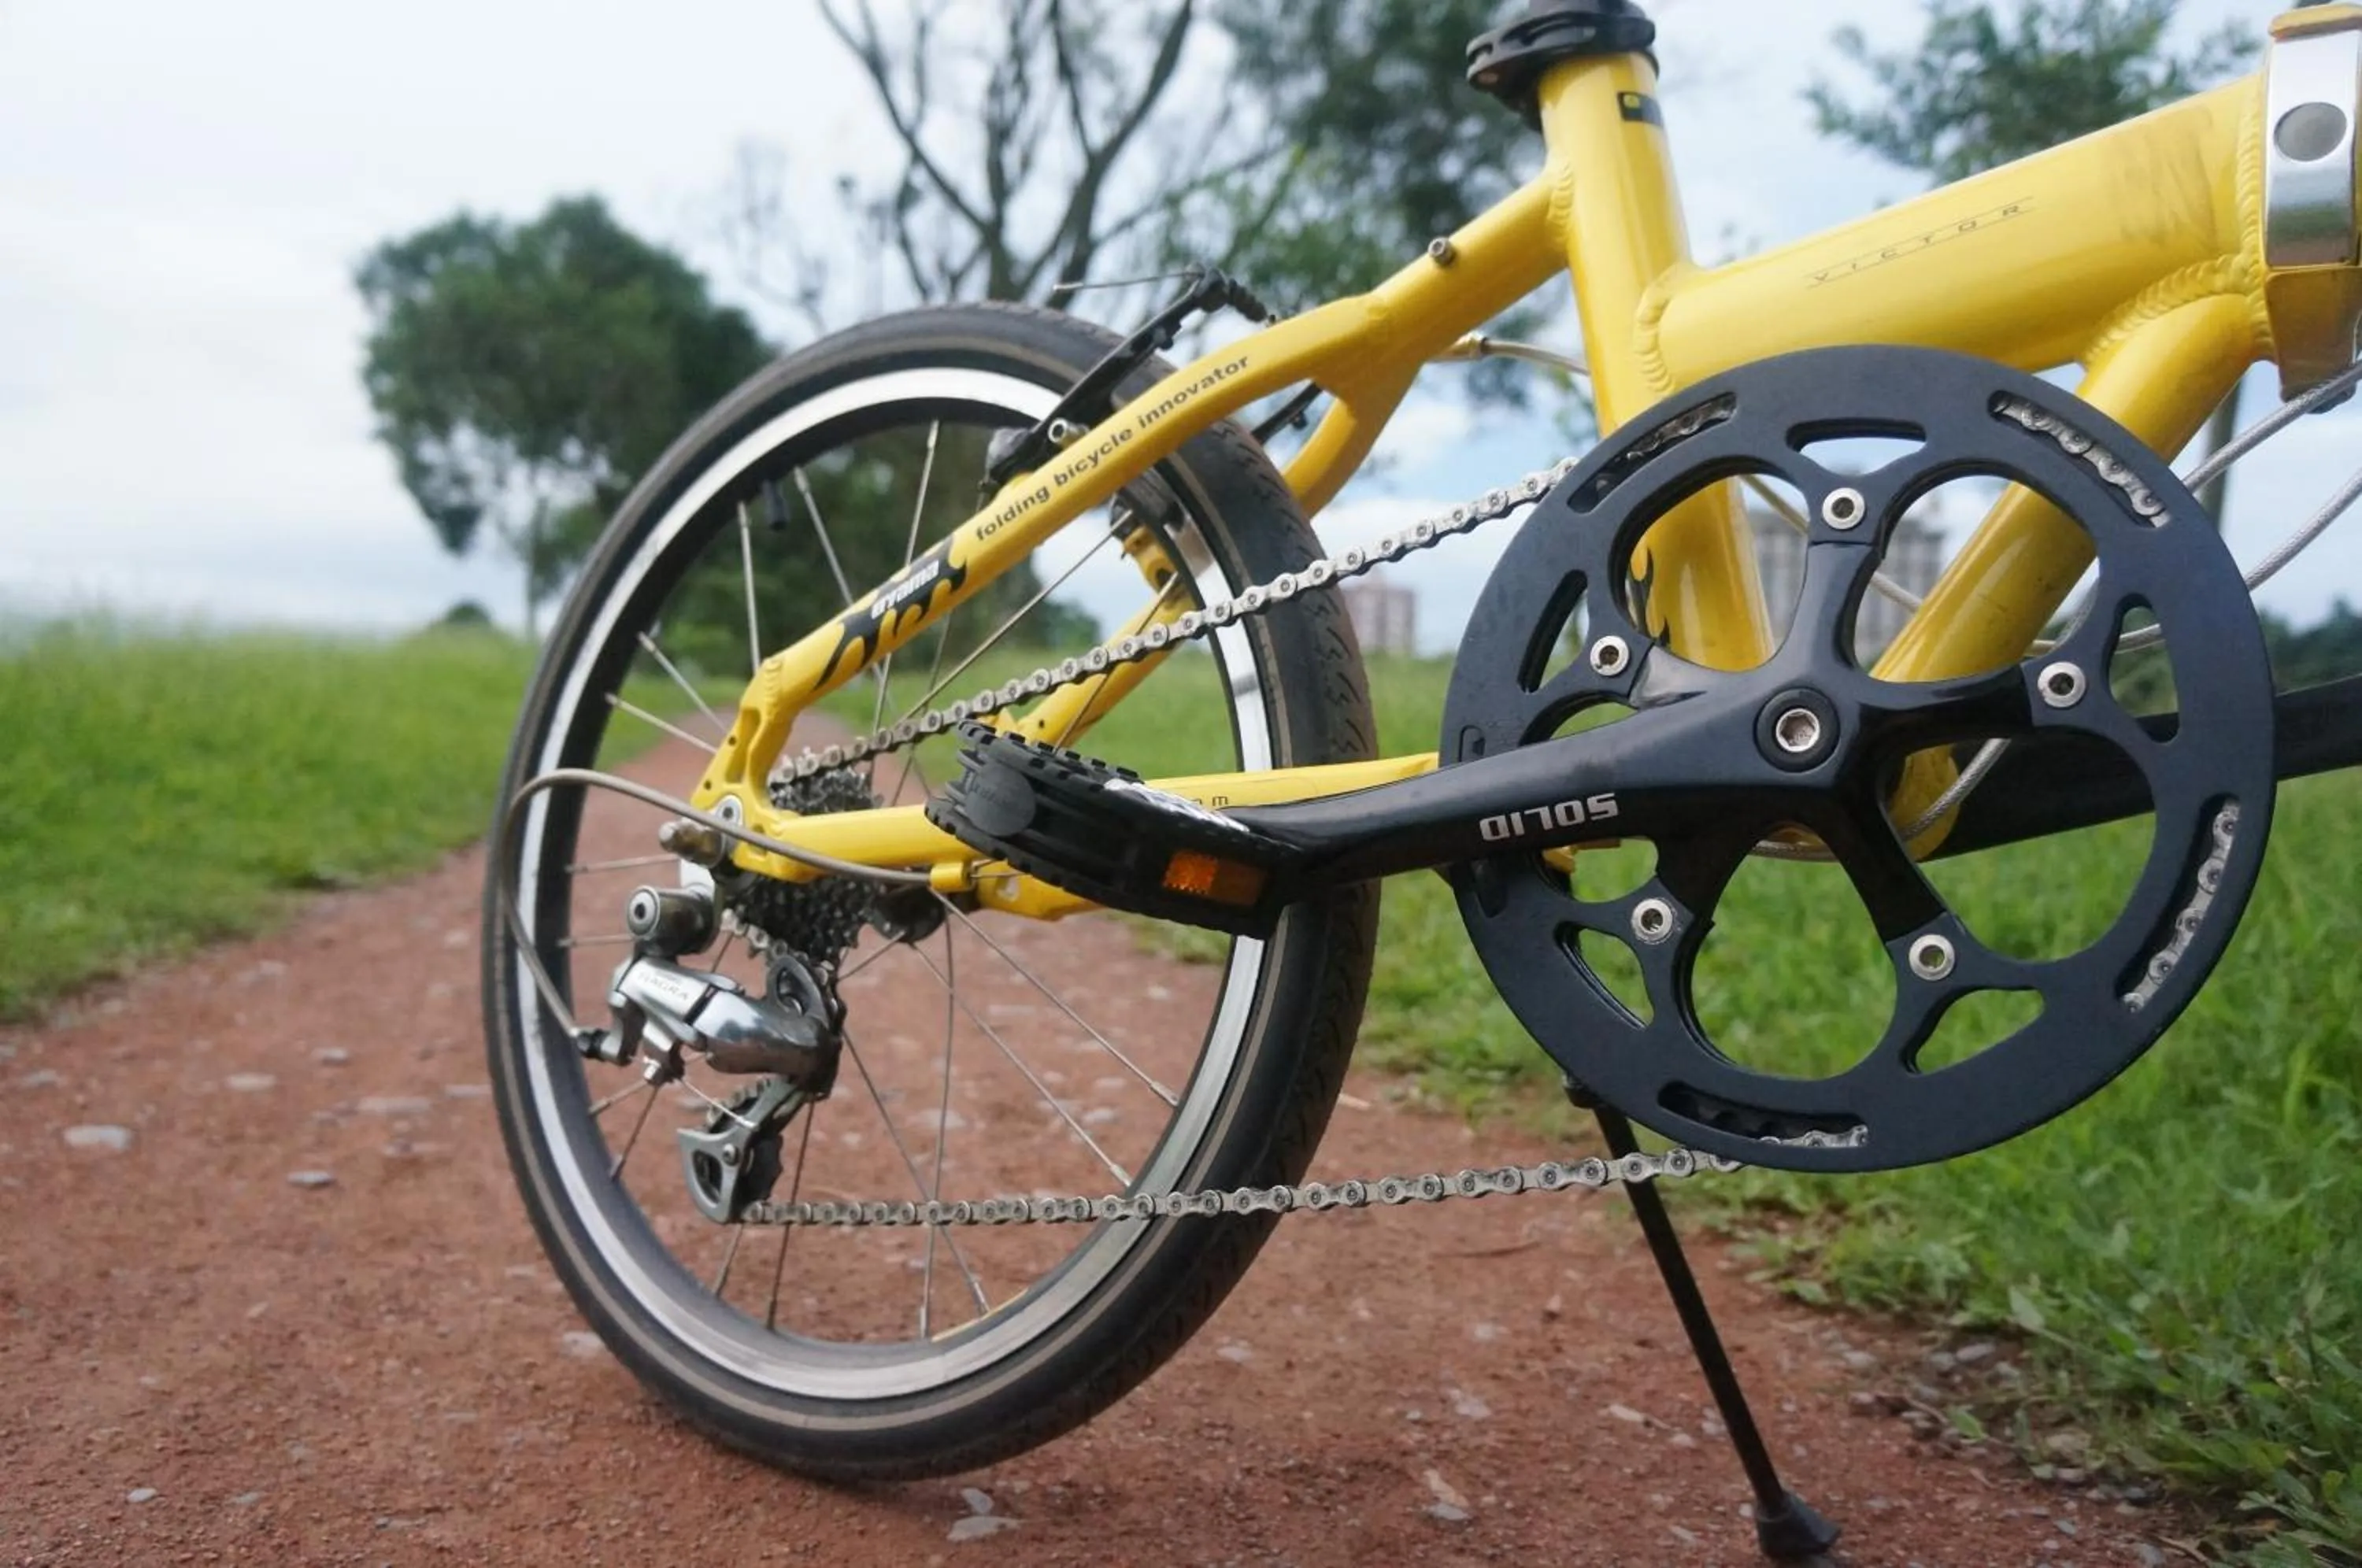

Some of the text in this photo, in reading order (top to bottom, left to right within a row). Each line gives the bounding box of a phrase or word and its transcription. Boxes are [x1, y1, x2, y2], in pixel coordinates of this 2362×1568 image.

[1813, 204, 2020, 281] VICTOR
[976, 356, 1249, 542] folding bicycle innovator
[1479, 792, 1620, 841] SOLID
